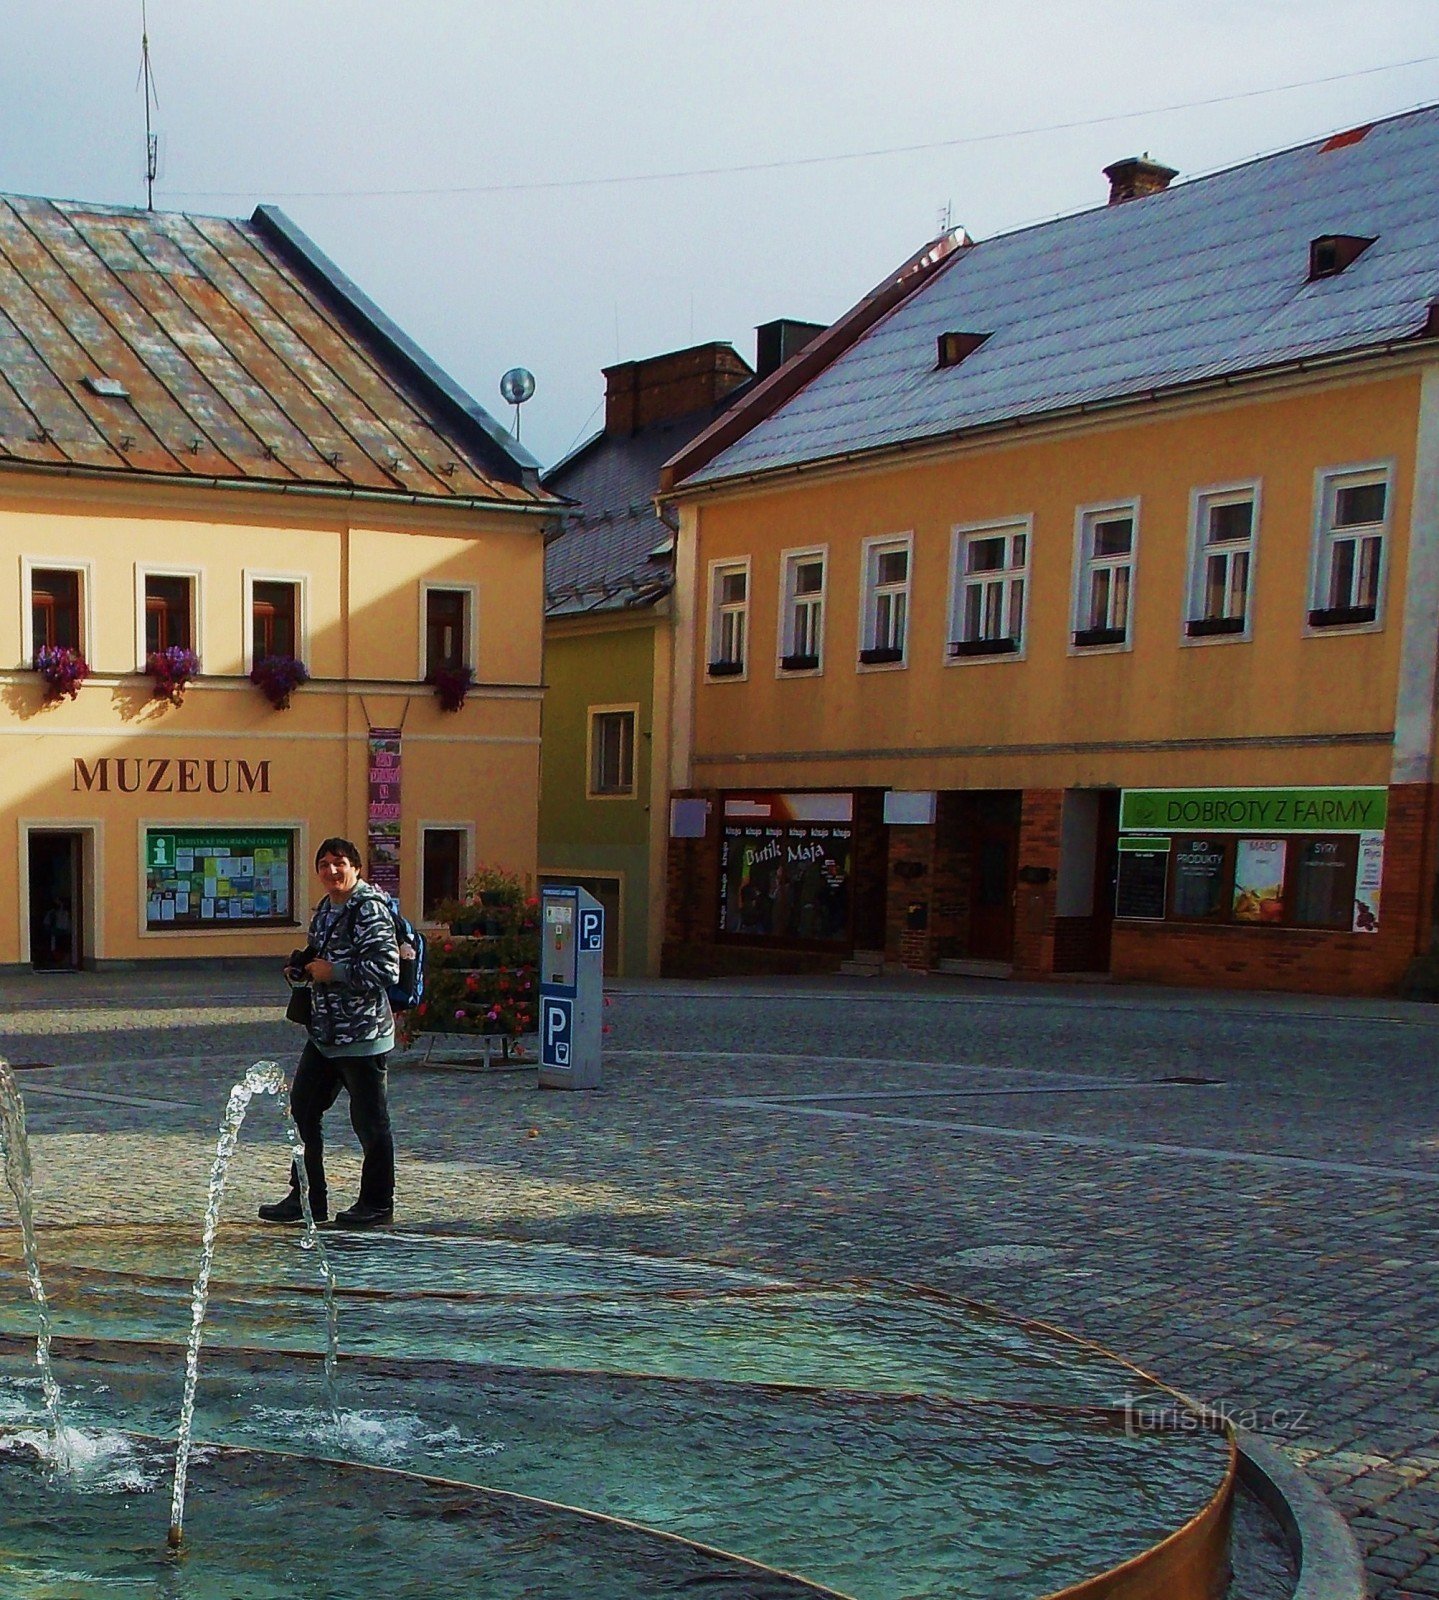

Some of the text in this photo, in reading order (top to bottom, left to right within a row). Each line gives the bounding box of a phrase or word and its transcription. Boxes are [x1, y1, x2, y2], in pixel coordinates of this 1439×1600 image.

[72, 758, 271, 793] MUZEUM
[1167, 800, 1373, 823] DOBROTY Z FARMY
[745, 839, 825, 866] Butik Maja
[1192, 841, 1208, 852] BIO
[1249, 841, 1278, 852] MASO
[1176, 853, 1222, 865] PRODUKTY
[584, 914, 599, 939] P
[548, 1007, 566, 1046] P
